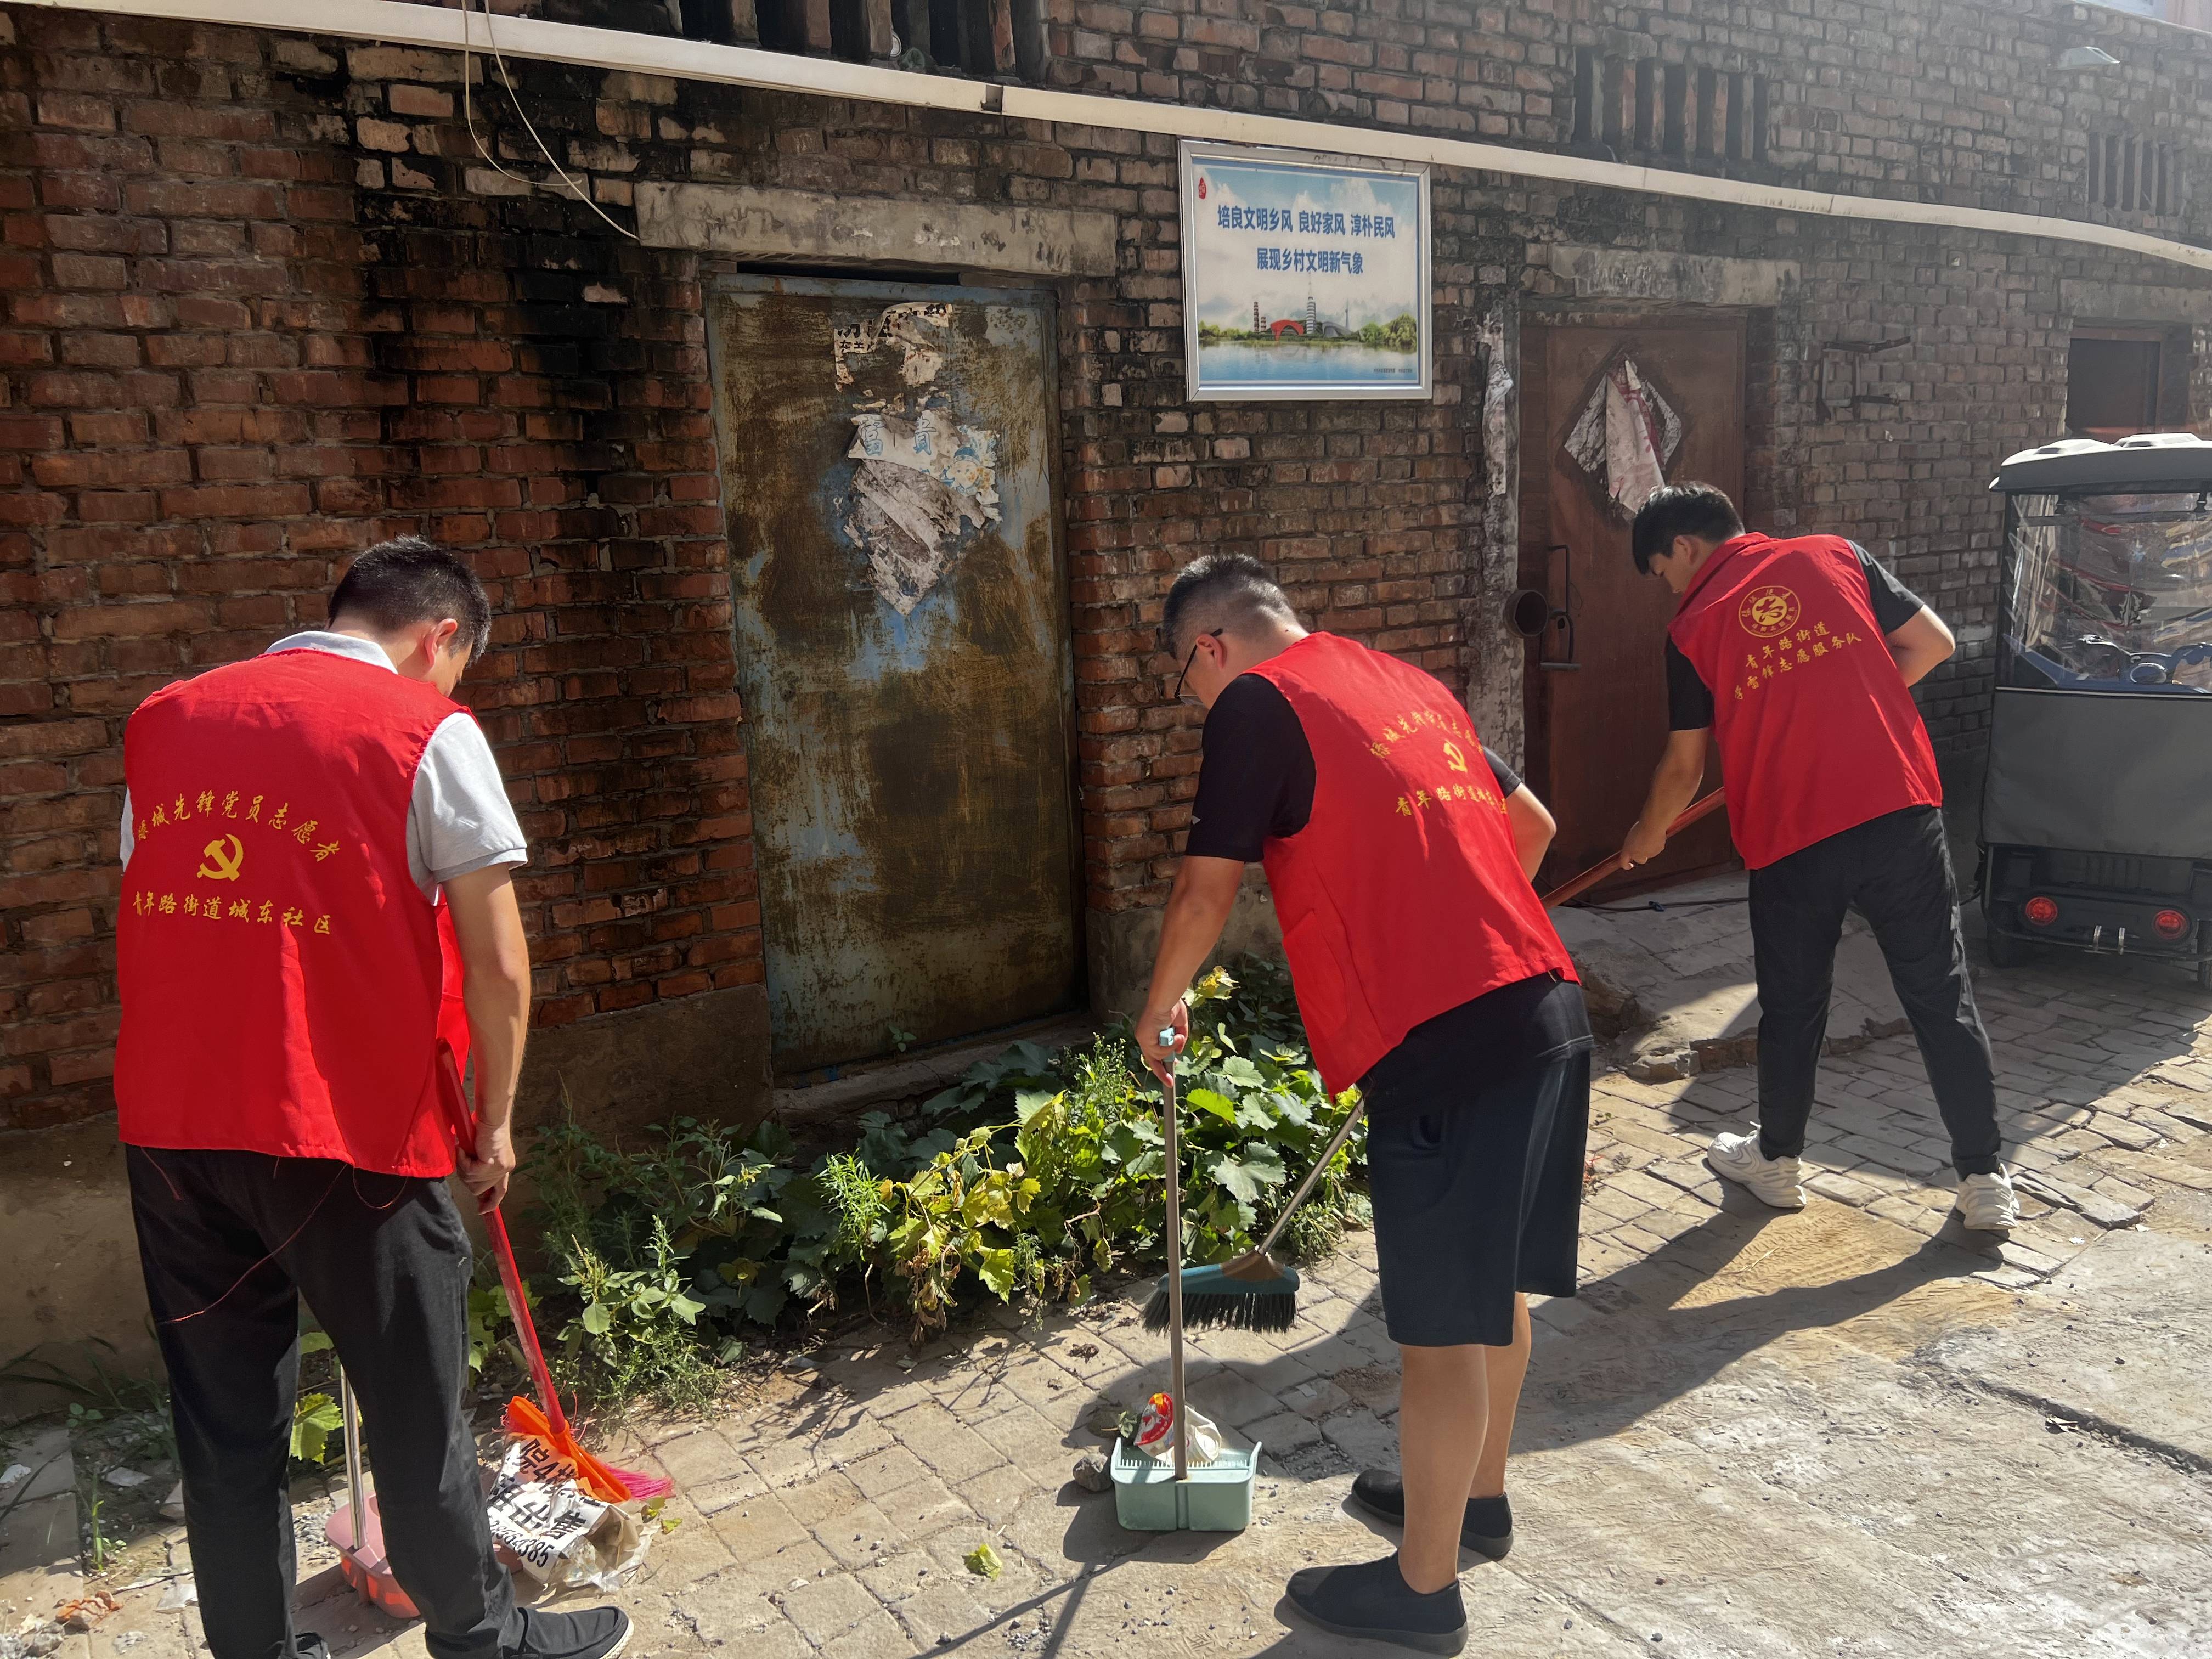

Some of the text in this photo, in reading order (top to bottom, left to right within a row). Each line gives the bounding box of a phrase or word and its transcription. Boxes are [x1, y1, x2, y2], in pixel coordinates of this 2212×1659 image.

[1217, 204, 1396, 239] 培良文明乡风 良好家风 淳朴民风
[1257, 247, 1363, 275] 展现乡村文明新气象
[1746, 621, 1830, 669] 青年路街道
[132, 890, 331, 935] 青年路街道城东社区
